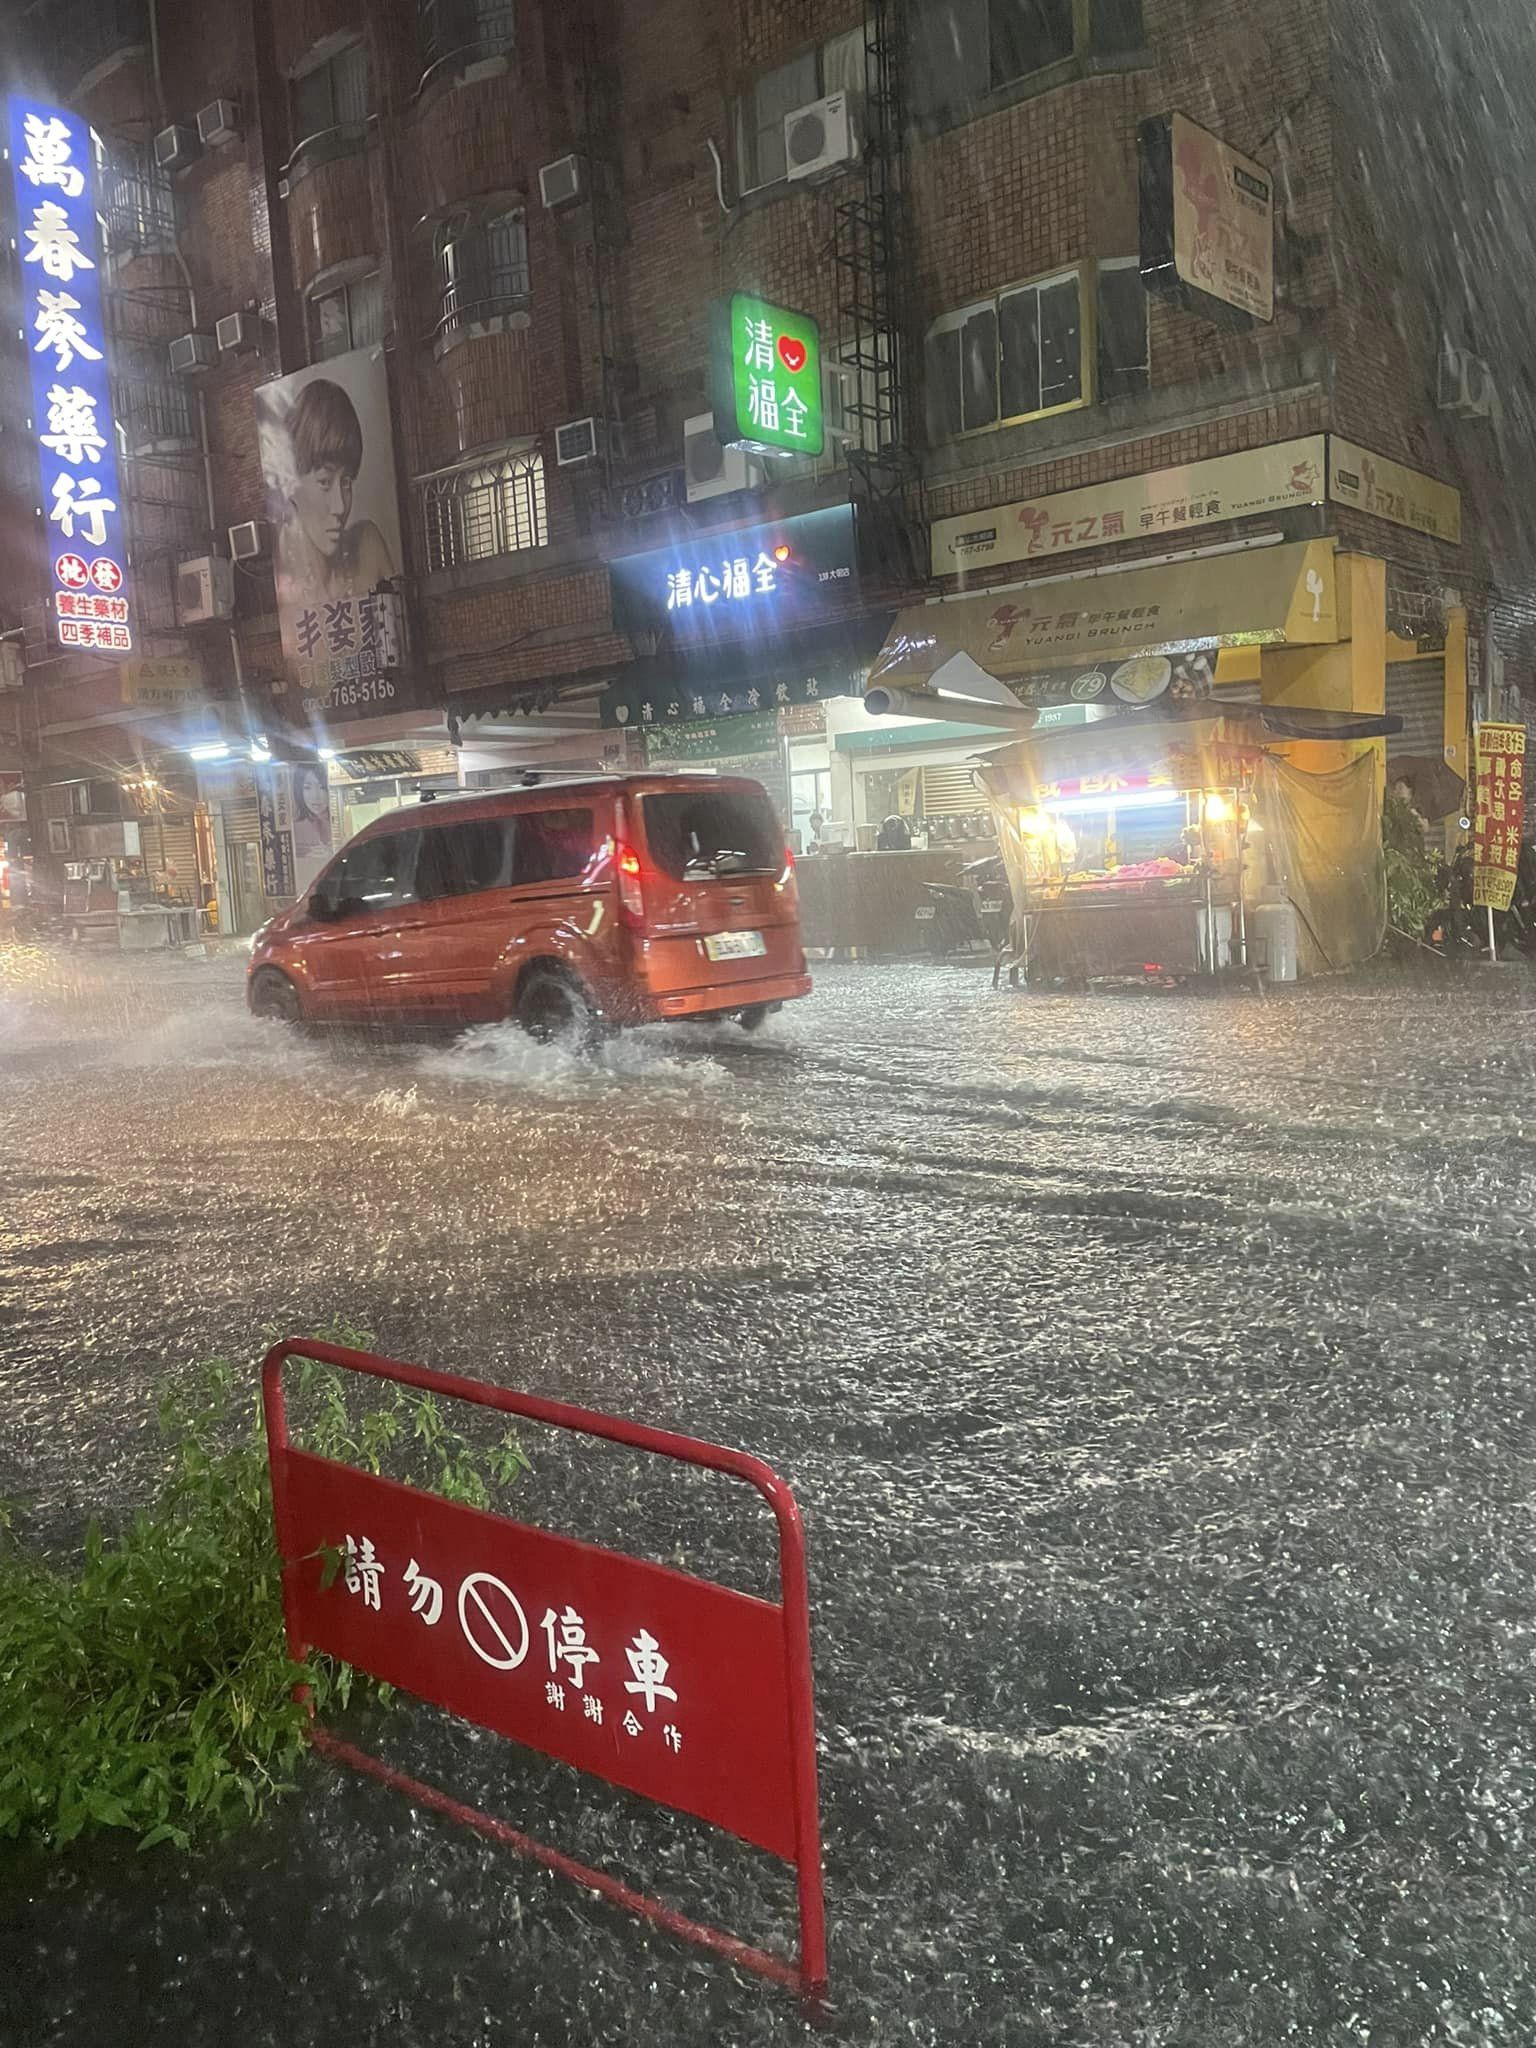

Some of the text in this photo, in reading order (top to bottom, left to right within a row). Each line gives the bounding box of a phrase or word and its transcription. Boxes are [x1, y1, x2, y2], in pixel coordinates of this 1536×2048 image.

[19, 113, 116, 546] 萬春蔘藥行
[745, 316, 774, 372] 清
[749, 373, 808, 438] 福全
[1052, 511, 1125, 547] 元之氣
[58, 556, 120, 590] 批發
[666, 552, 778, 610] 清心福全
[57, 592, 127, 621] 養生藥材
[59, 622, 130, 648] 四季補品
[1087, 622, 1155, 638] BRUNCH
[1077, 677, 1101, 694] 79
[344, 1534, 678, 1713] 請勿 停車
[544, 1682, 683, 1753] 謝謝合作
